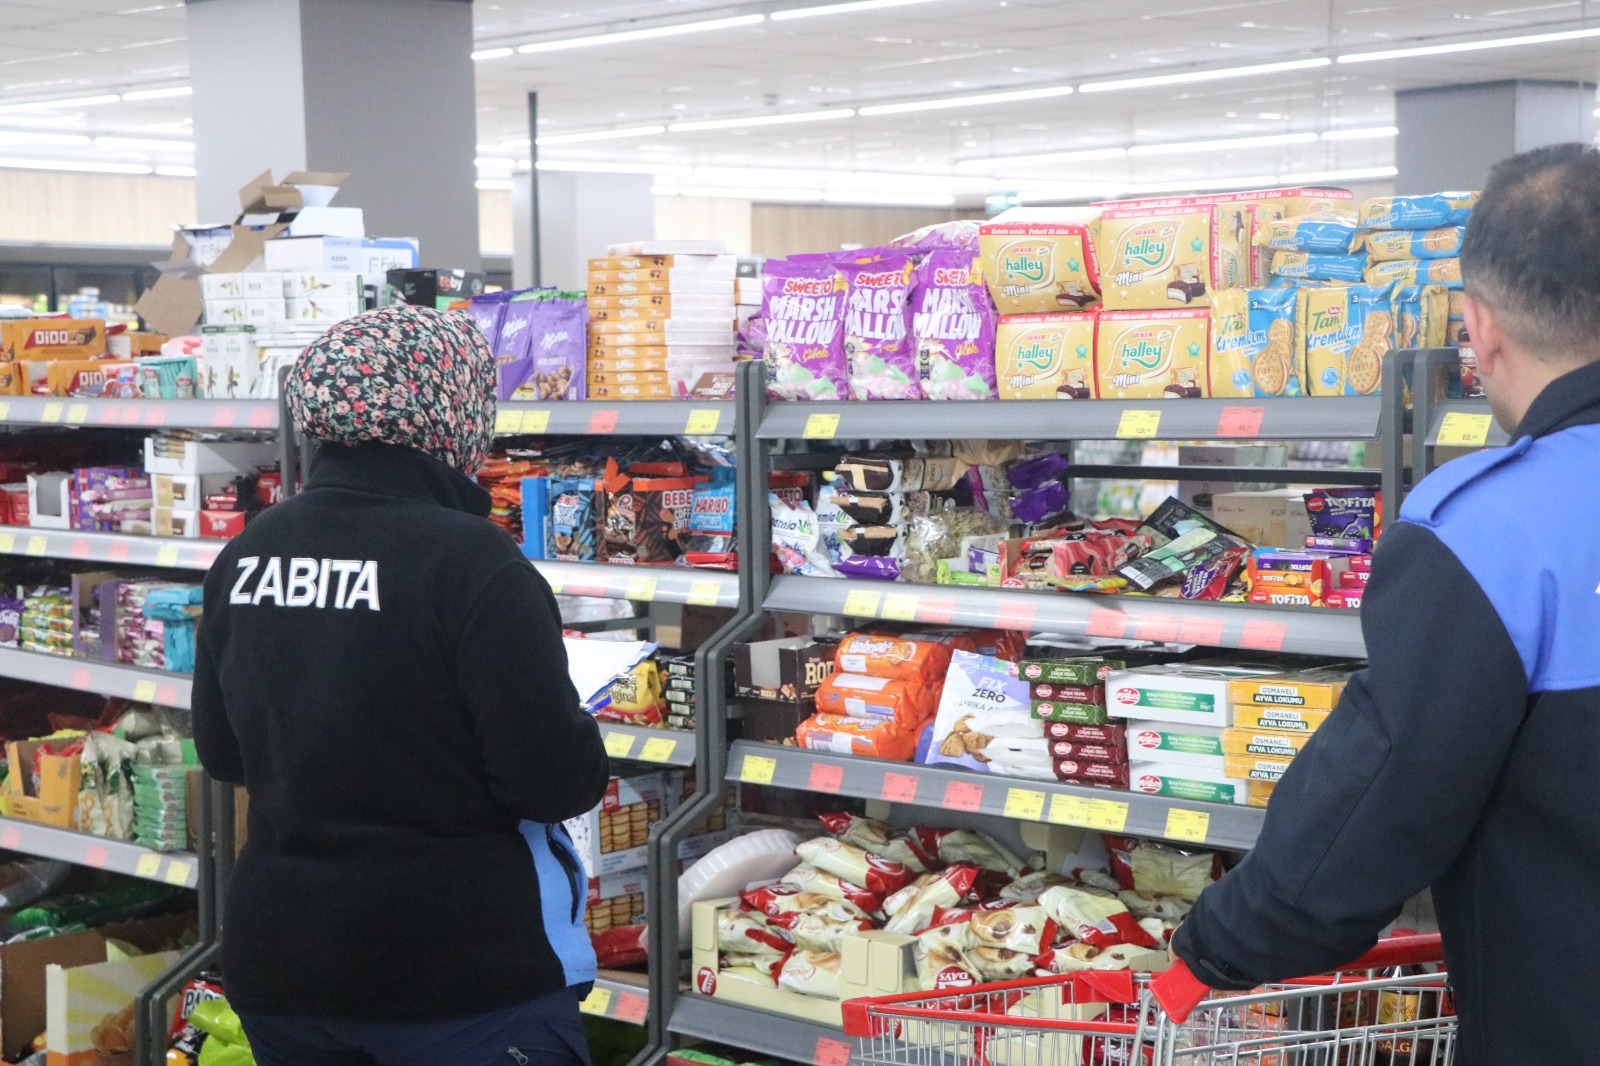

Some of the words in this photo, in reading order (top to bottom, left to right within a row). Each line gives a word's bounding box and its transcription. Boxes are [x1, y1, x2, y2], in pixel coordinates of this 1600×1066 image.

[1124, 238, 1165, 263] halley
[1005, 256, 1043, 278] halley
[1116, 271, 1143, 286] Mini
[783, 279, 833, 296] SWEETO
[1004, 285, 1030, 297] Mini
[770, 295, 837, 322] MARSH
[1017, 343, 1054, 367] halley
[1121, 341, 1163, 366] halley
[1010, 374, 1034, 389] Mini
[1113, 372, 1140, 388] Mini
[662, 489, 695, 509] BEBE
[693, 496, 729, 514] HARIBO
[229, 555, 381, 612] ZABITA
[977, 676, 1009, 692] FIX
[971, 688, 1006, 703] ZERO
[1254, 695, 1273, 703] AYVA
[1274, 696, 1303, 705] LOKUMU
[1259, 719, 1278, 727] AYVA
[1278, 720, 1307, 729] LOKUMU
[1267, 746, 1296, 755] LOKUMU
[1250, 770, 1270, 778] AYVA
[939, 972, 968, 981] DAYS
